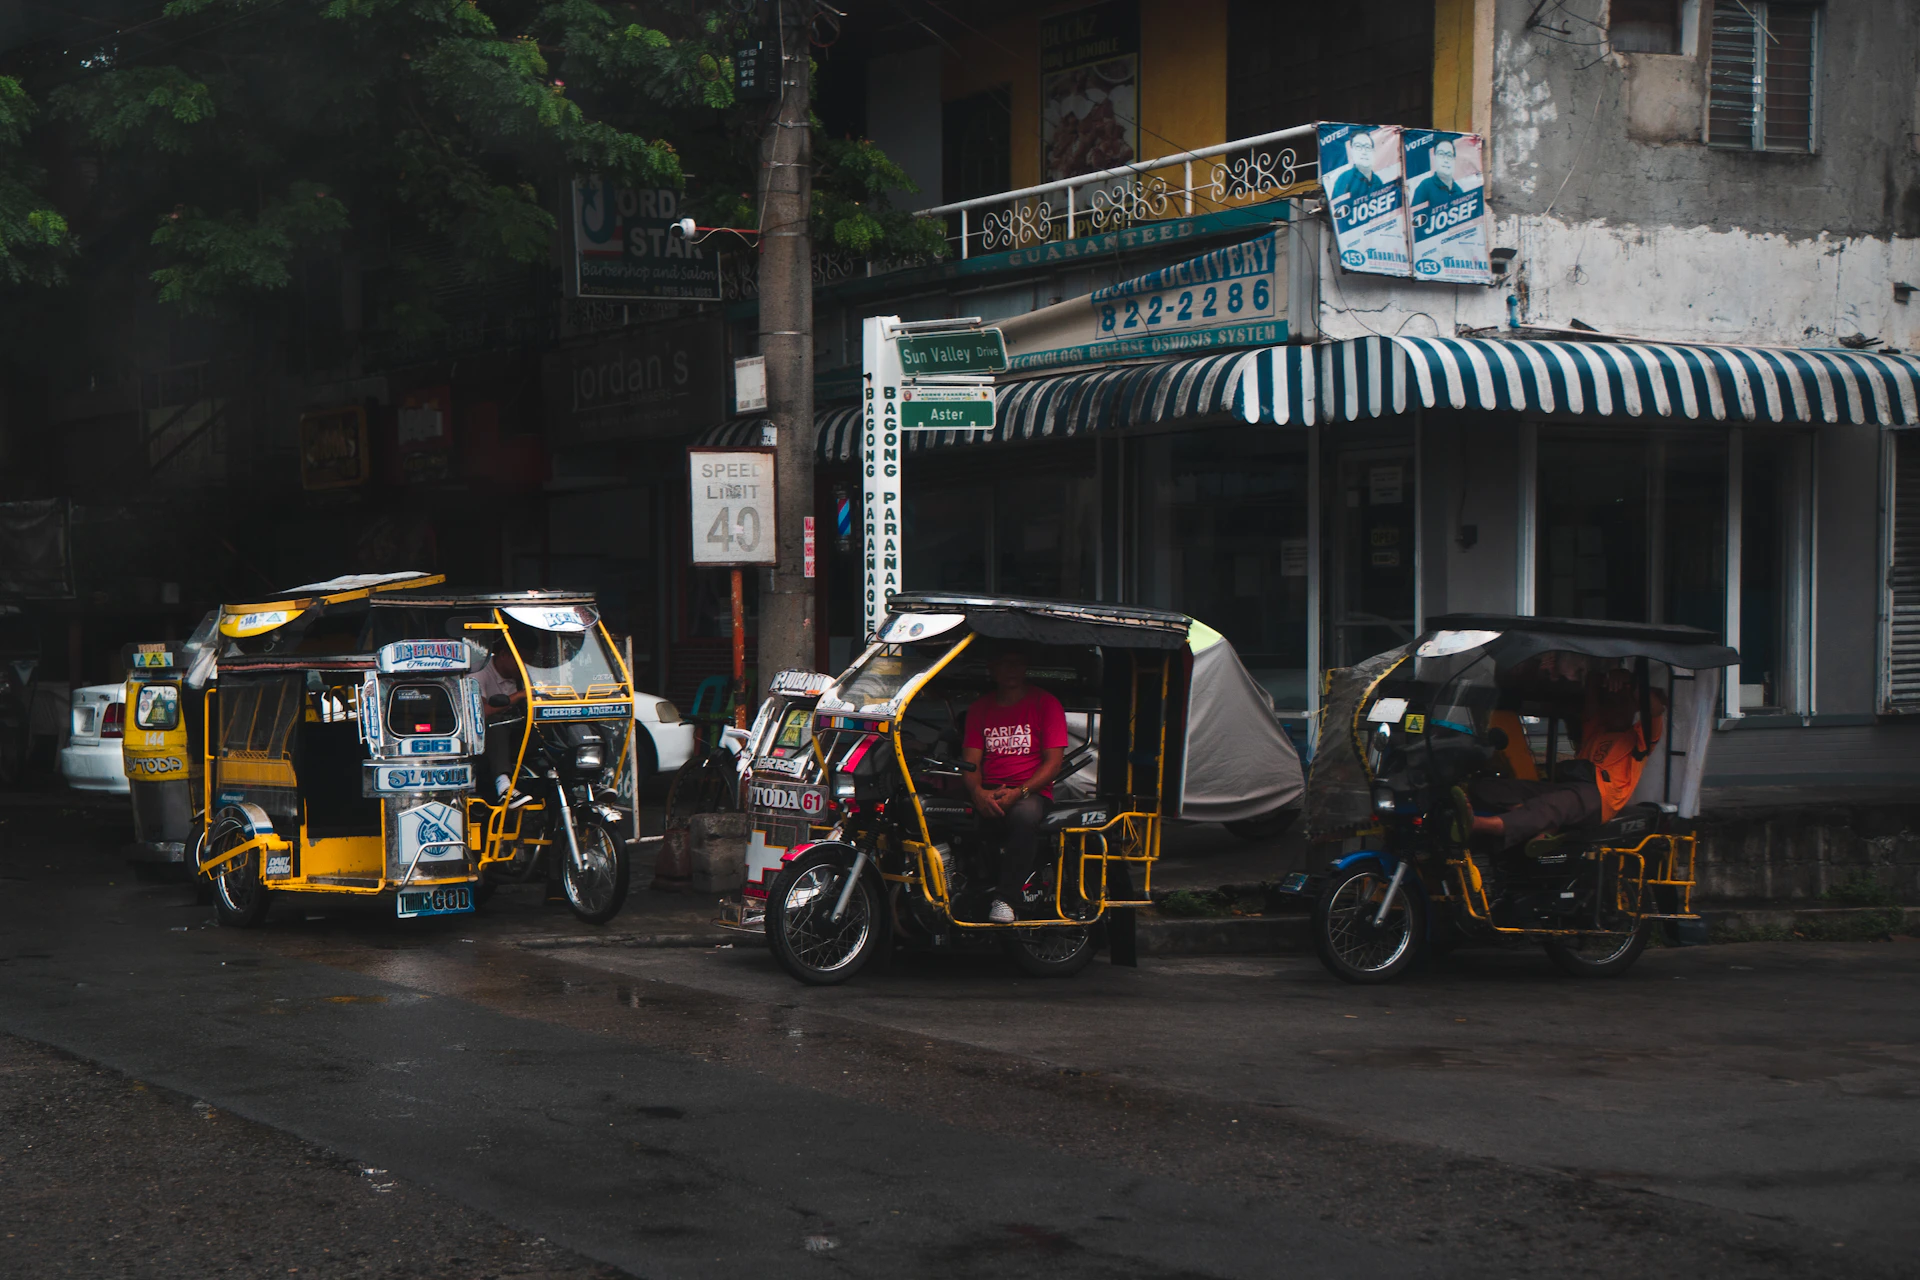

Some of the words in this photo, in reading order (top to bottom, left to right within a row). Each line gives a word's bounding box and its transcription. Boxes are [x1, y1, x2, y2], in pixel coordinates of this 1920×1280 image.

[1348, 191, 1397, 225] JOSEF
[1424, 199, 1478, 234] JOSEF
[1160, 236, 1276, 288] DELIVERY
[1344, 252, 1363, 266] 153
[1417, 261, 1438, 273] 153
[652, 265, 680, 279] and
[681, 265, 718, 280] Salon
[1101, 278, 1270, 332] 822-2286
[1089, 340, 1146, 360] REVERSE
[1151, 335, 1212, 353] OSMOSIS
[1216, 325, 1276, 346] SYSTEM
[903, 349, 928, 365] Sun
[931, 345, 971, 364] Valley
[975, 345, 999, 358] Drive
[571, 341, 689, 413] jordan's
[930, 408, 963, 420] Aster
[865, 387, 876, 478] BAGONG
[883, 386, 898, 478] BAGONG
[706, 506, 761, 553] 40
[865, 491, 876, 631] PARAÑAQUE
[145, 731, 165, 747] 144
[983, 724, 1032, 737] CARITAS
[411, 740, 452, 753] 66
[985, 735, 1031, 749] CONTRA
[803, 793, 821, 811] 61
[1081, 811, 1107, 823] 175
[266, 865, 291, 875] GRIND
[268, 856, 290, 866] DAILY
[432, 888, 470, 911] GOD
